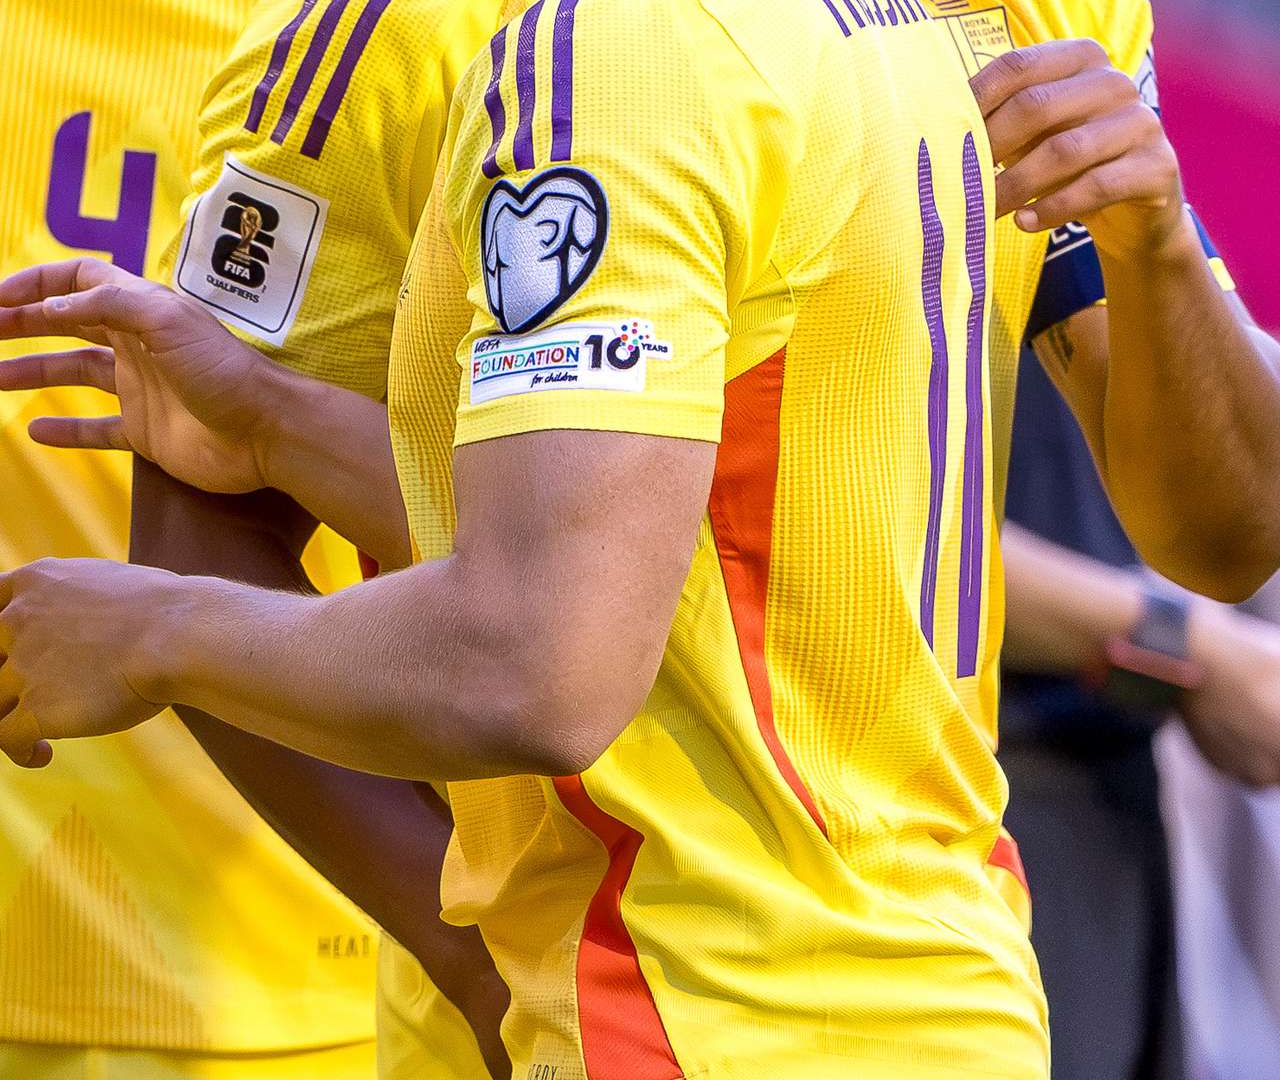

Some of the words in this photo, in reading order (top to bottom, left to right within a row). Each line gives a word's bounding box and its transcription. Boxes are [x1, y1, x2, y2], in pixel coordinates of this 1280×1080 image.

[45, 110, 157, 277] 4
[223, 260, 251, 280] FIFA
[206, 274, 260, 303] QUALIFIERS
[474, 339, 501, 353] UEFA
[584, 334, 641, 370] 10
[641, 342, 669, 353] YEARS
[472, 347, 580, 379] FOUNDATION
[530, 374, 544, 388] for
[544, 373, 578, 384] children
[918, 131, 986, 678] 11
